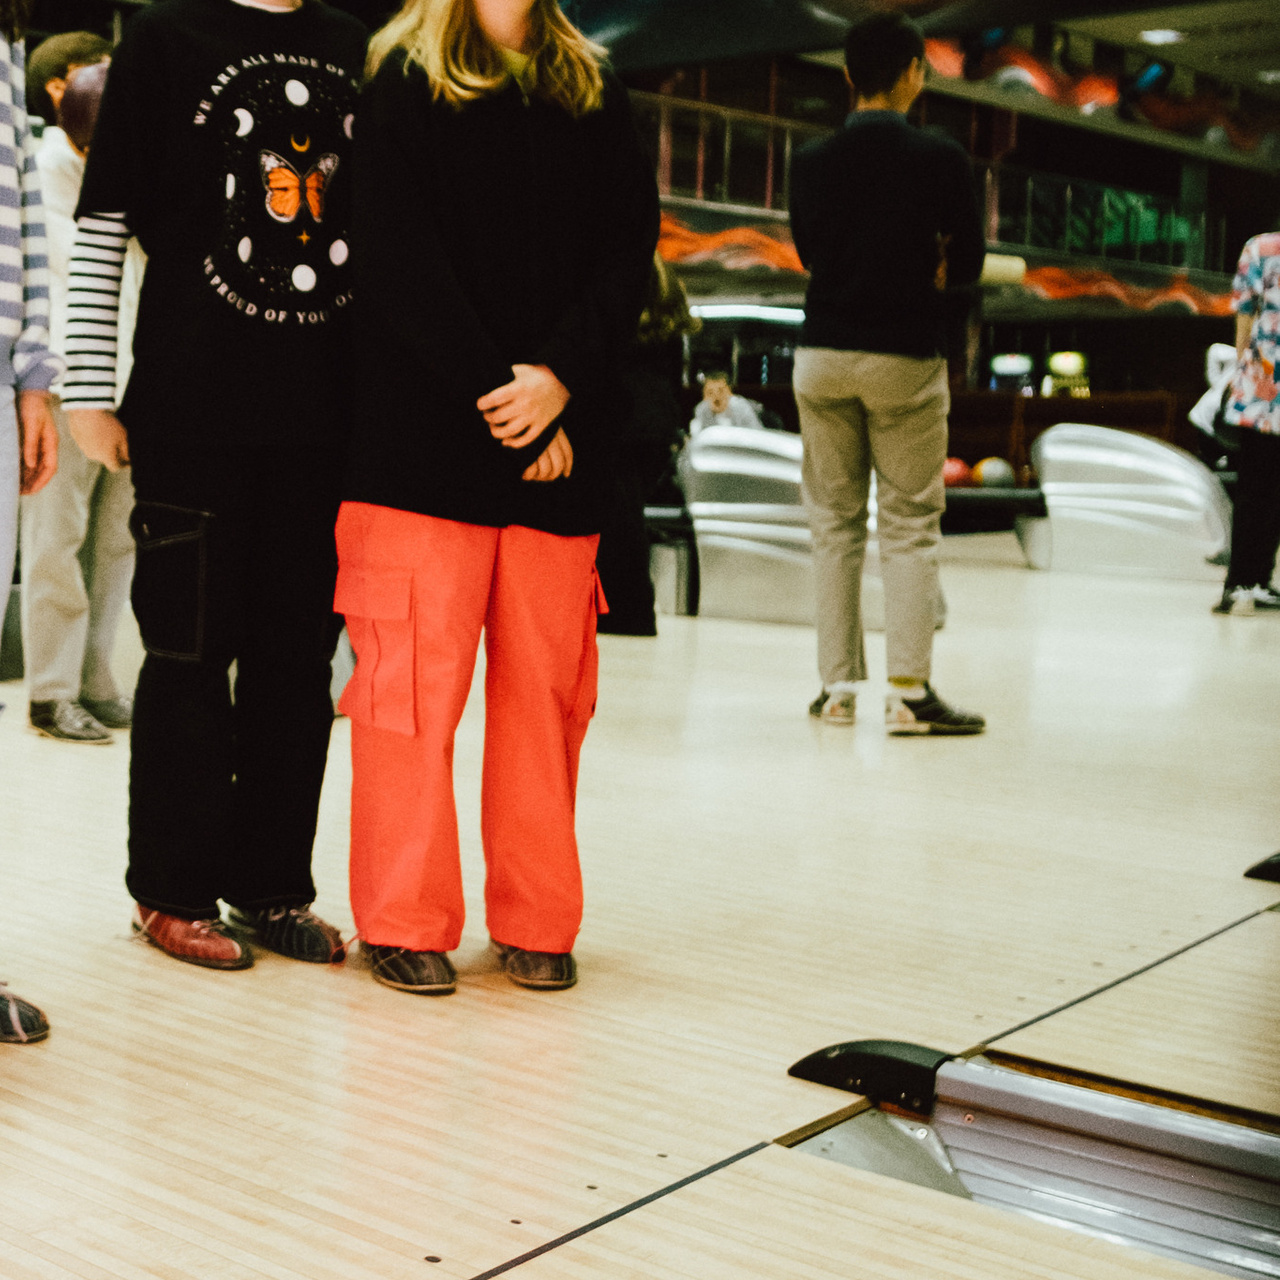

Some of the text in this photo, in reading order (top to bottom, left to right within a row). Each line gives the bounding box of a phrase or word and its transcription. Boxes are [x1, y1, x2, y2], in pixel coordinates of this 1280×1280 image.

[193, 98, 213, 125] WE
[210, 63, 240, 96] ARE
[241, 53, 270, 69] ALL
[273, 52, 320, 69] MADE
[210, 274, 258, 317] PROUD
[264, 308, 288, 324] OF
